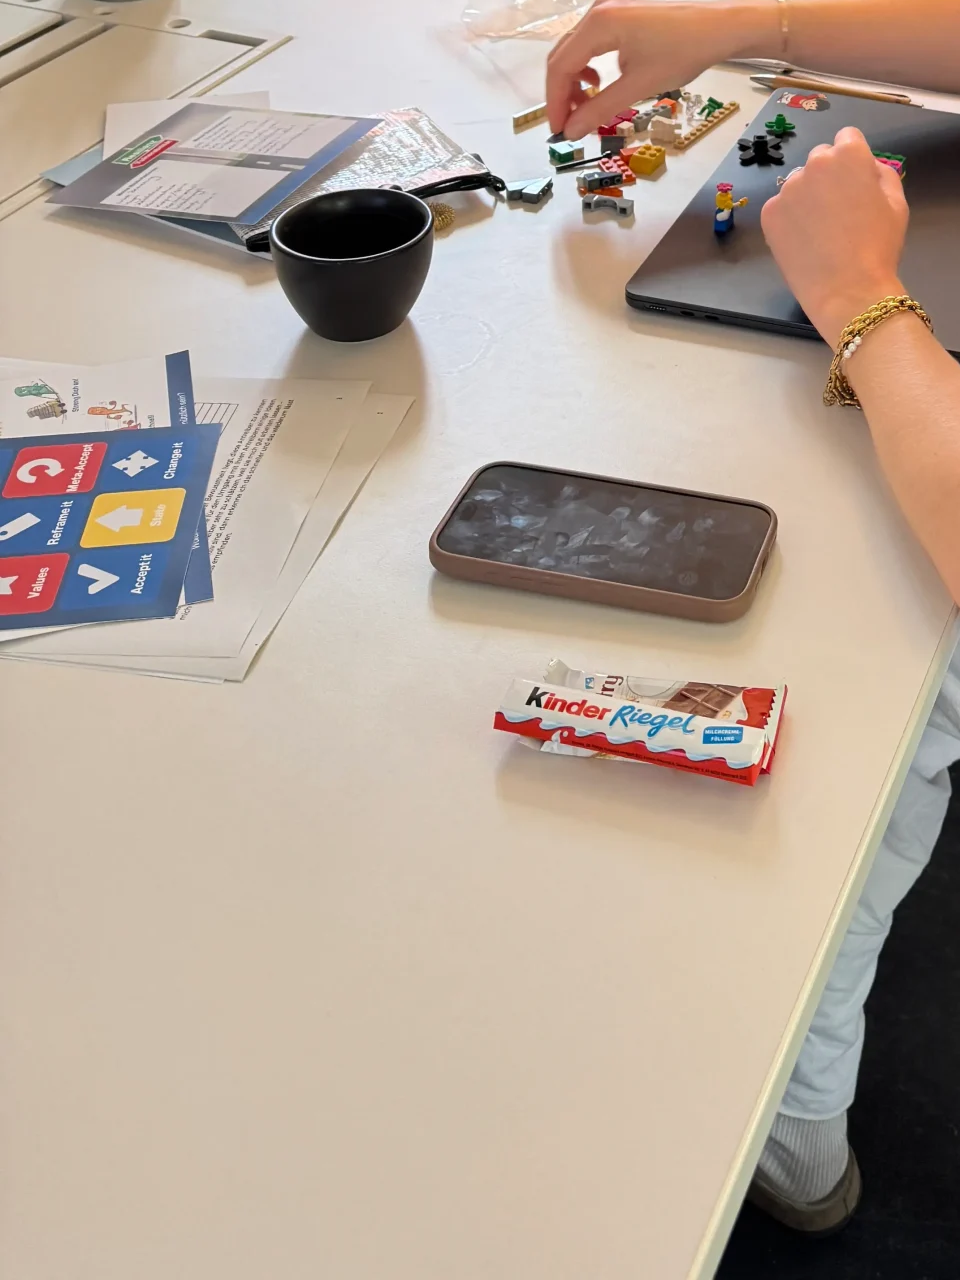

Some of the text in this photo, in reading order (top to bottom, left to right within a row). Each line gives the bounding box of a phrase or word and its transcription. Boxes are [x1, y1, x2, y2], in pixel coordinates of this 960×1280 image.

[66, 444, 93, 493] Meta-Accept
[163, 448, 182, 479] Change
[46, 508, 70, 545] Reframe
[150, 504, 166, 527] State
[27, 567, 49, 599] Values
[130, 561, 151, 594] Accept
[609, 705, 697, 737] Riegel
